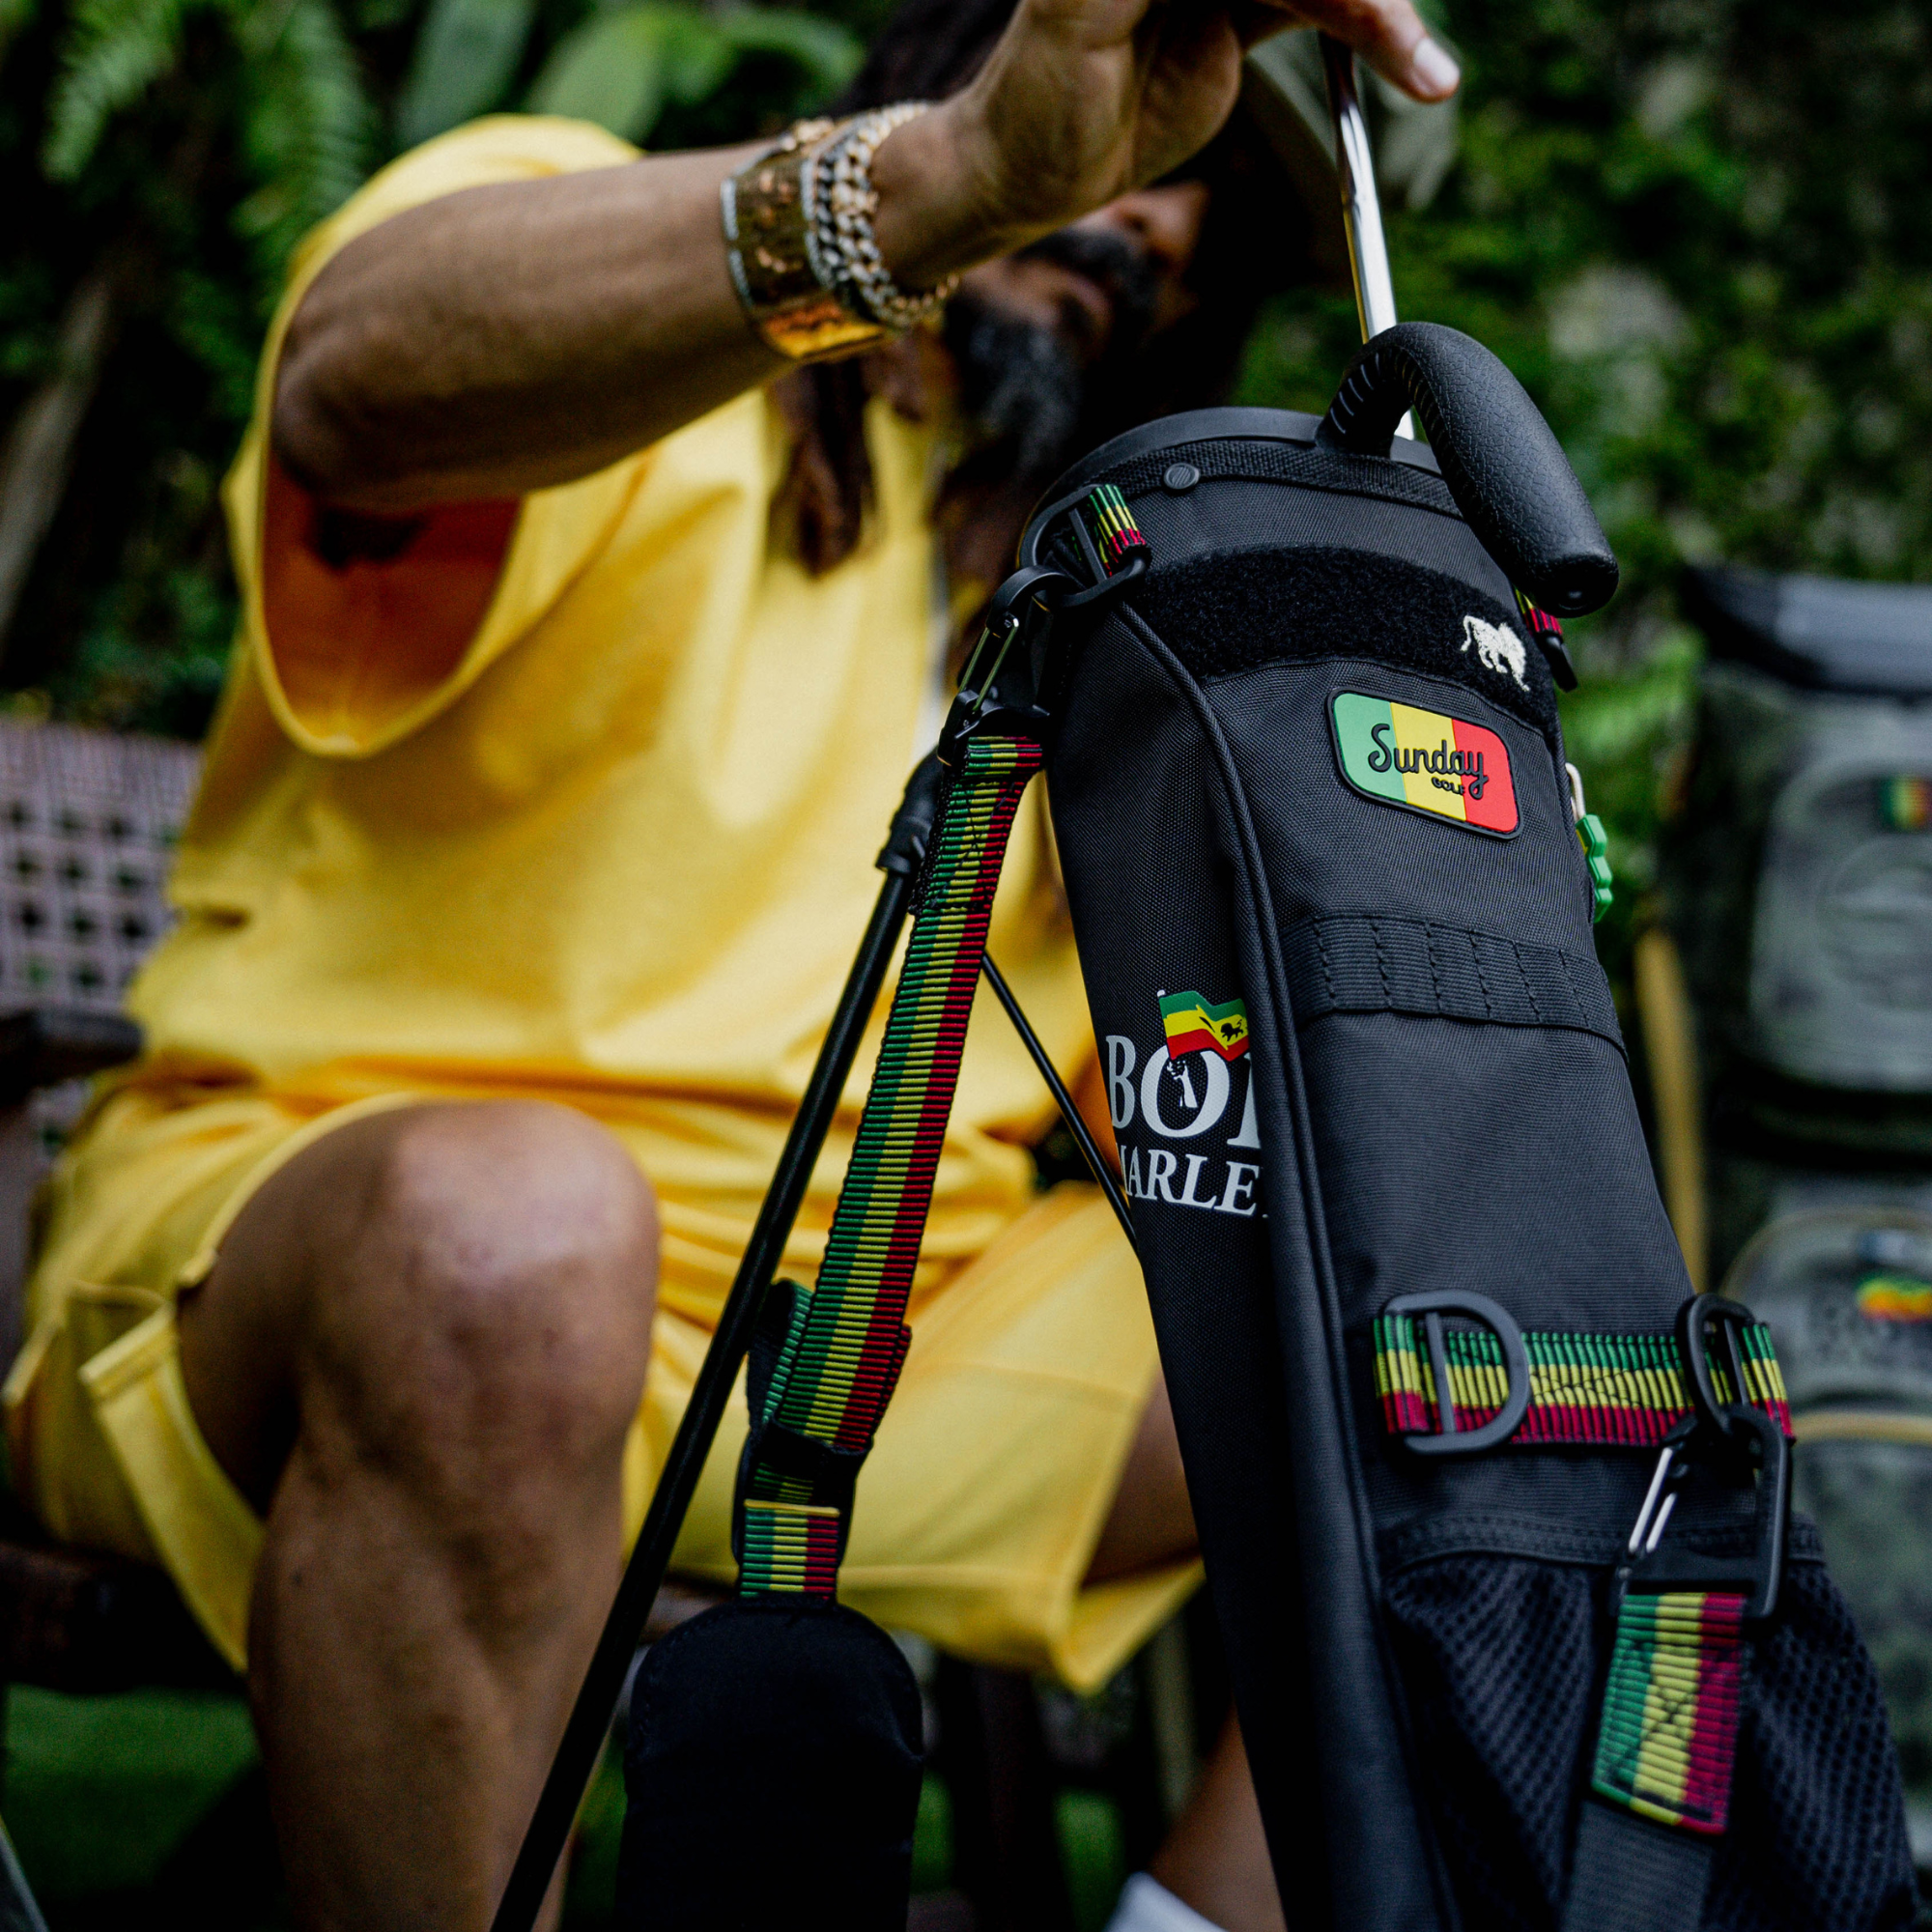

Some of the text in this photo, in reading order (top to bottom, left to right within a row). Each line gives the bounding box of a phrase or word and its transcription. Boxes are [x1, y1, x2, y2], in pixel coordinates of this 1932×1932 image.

[1368, 723, 1489, 800] Sunday
[1431, 777, 1465, 796] GOLF
[1116, 1142, 1267, 1218] ARLE
